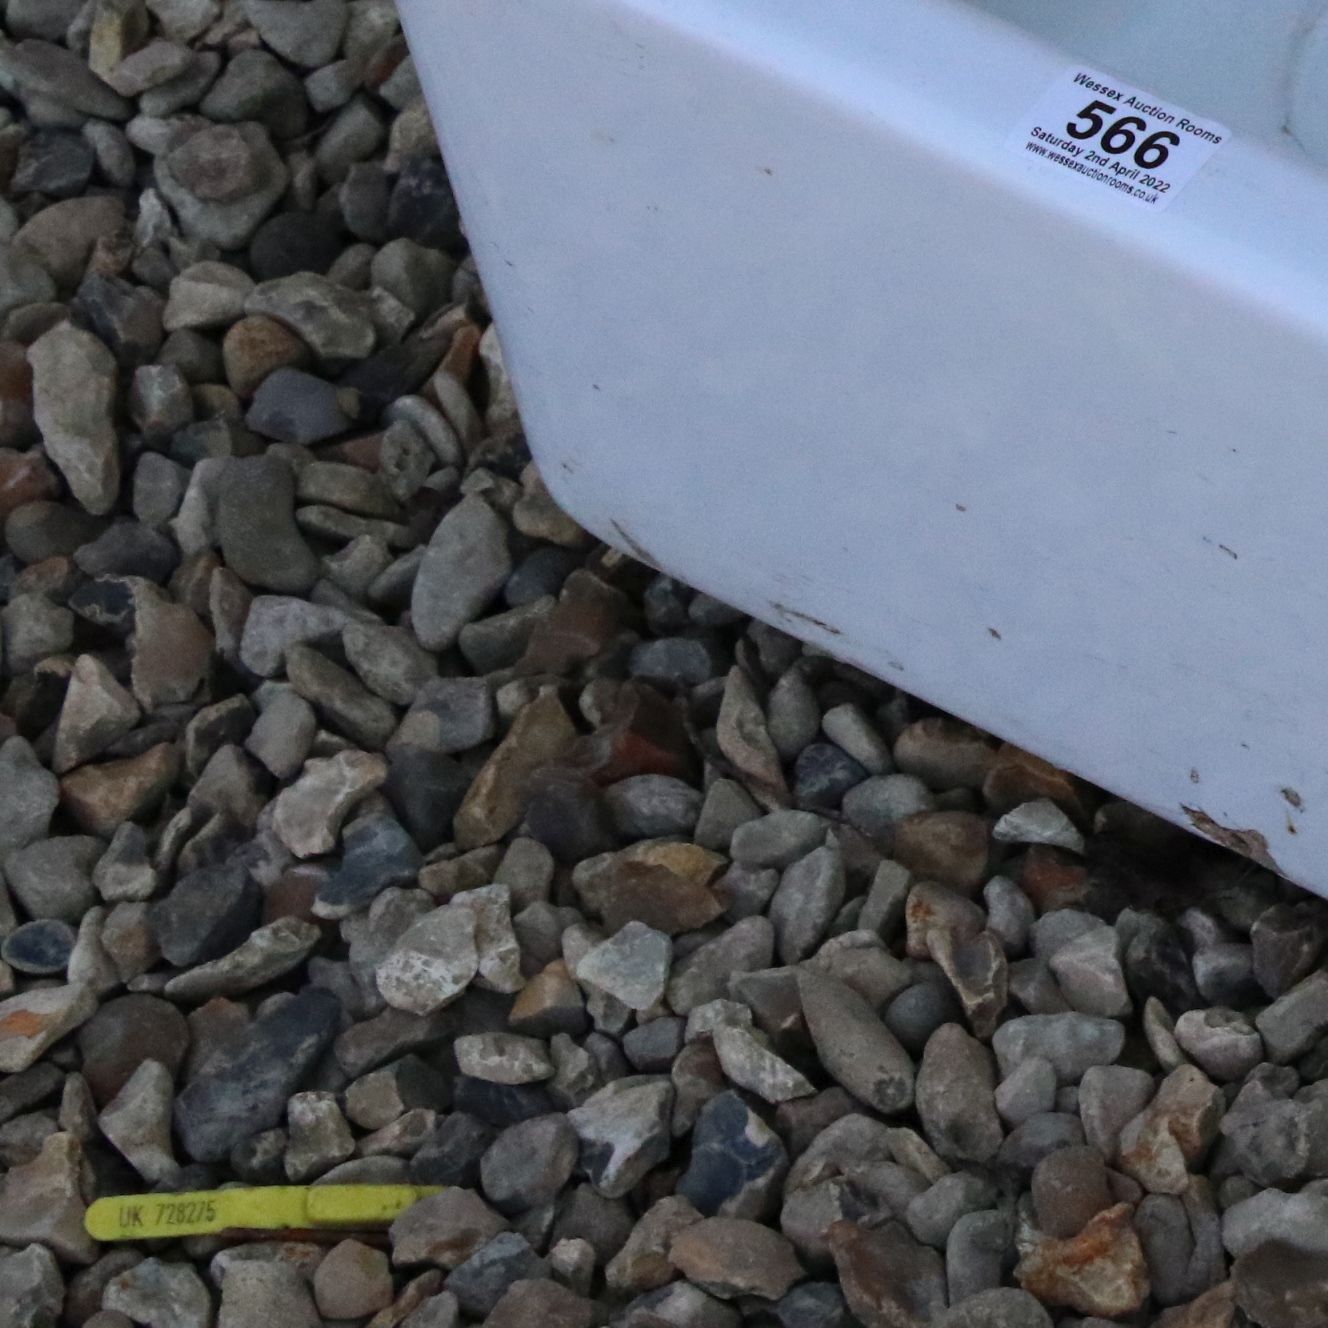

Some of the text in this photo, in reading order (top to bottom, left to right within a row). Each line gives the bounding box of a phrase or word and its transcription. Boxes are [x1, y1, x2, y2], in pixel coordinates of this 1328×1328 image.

[1065, 99, 1180, 170] 566
[1072, 72, 1223, 145] Wessex Auction Rooms
[1025, 140, 1159, 205] www.wessexauctionrooms.co.uk
[1030, 126, 1172, 194] Saturday 2nd April 2022
[119, 1200, 217, 1228] UK 728275
